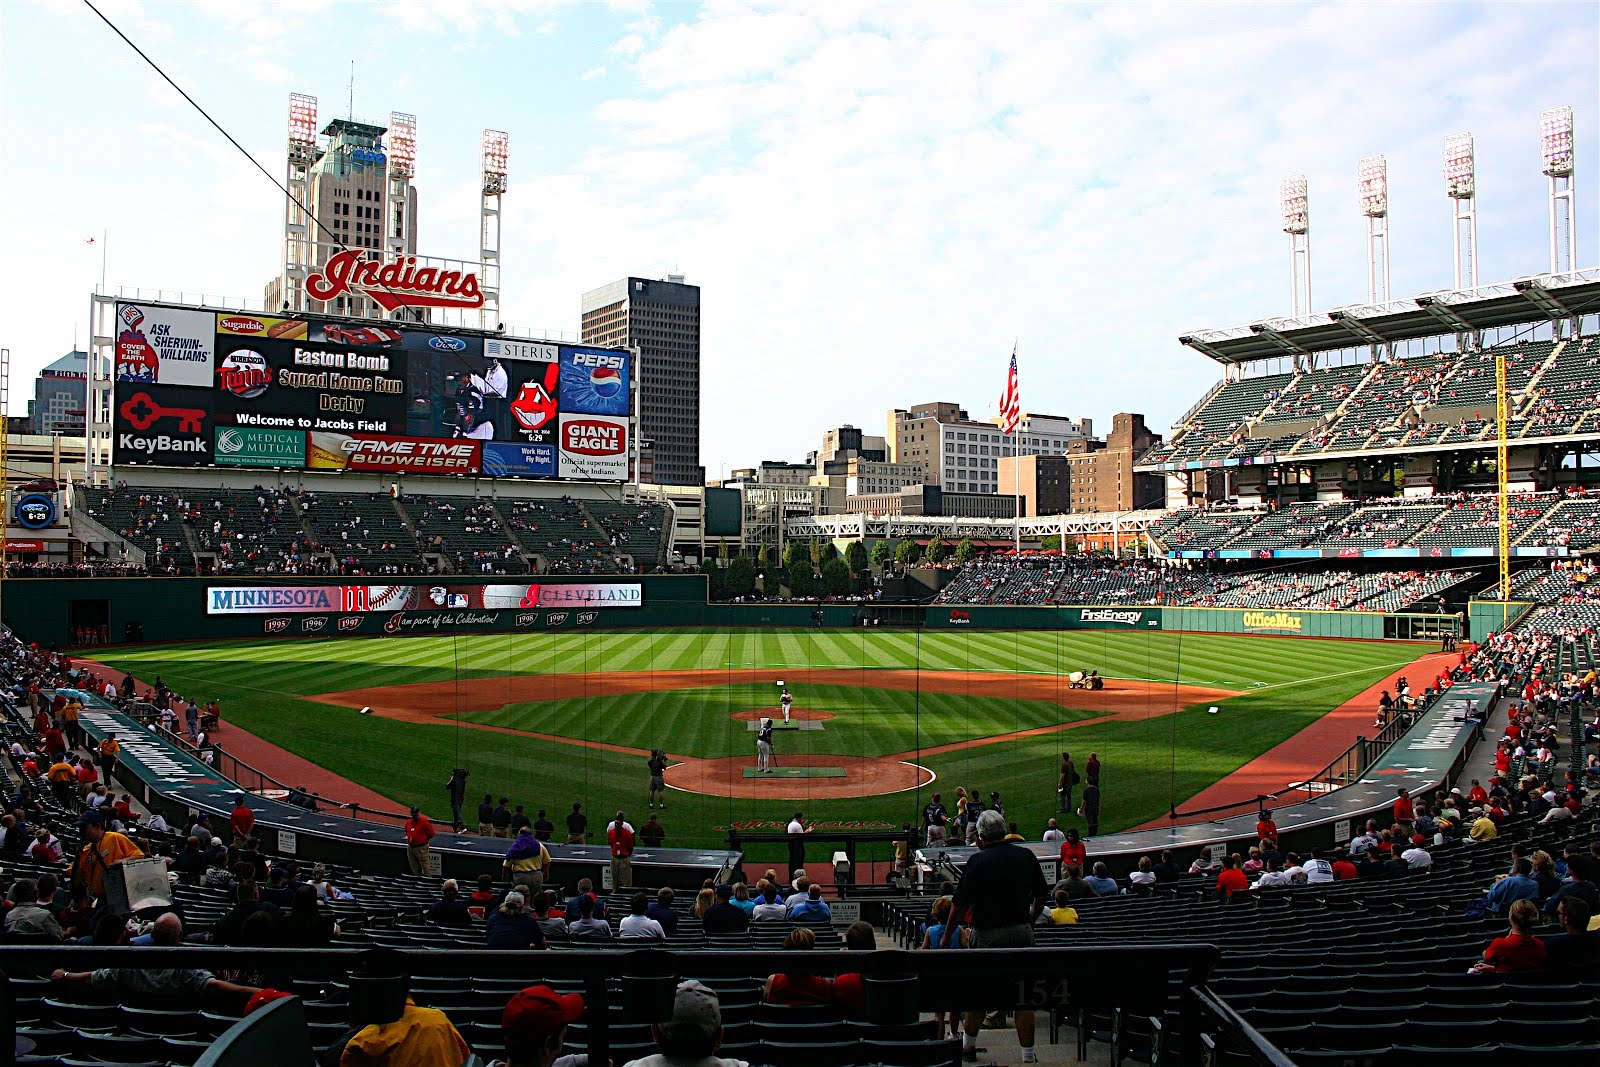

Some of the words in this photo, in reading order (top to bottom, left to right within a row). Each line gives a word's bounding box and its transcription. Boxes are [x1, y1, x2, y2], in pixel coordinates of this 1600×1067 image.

[305, 249, 485, 312] Indians
[150, 324, 171, 336] ASK
[222, 320, 264, 331] Sugardale
[154, 336, 203, 350] SHERWIN-
[160, 348, 208, 362] WILLIAMS
[504, 344, 552, 360] STERIS
[294, 348, 344, 368] Easton
[348, 352, 390, 371] Bomb
[572, 353, 624, 370] PEPSI
[215, 368, 274, 392] Twins
[279, 369, 328, 388] Squad
[330, 372, 372, 392] Home
[374, 376, 403, 394] Run
[320, 394, 364, 414] Derby
[236, 414, 295, 428] Welcome
[298, 418, 312, 428] to
[314, 418, 354, 430] Jacobs
[358, 420, 387, 432] Field
[528, 434, 542, 442] 6:29
[568, 425, 620, 438] GIANT
[120, 434, 206, 454] KeyBank
[248, 434, 300, 444] MEDICAL
[569, 438, 618, 450] EAGLE
[248, 444, 300, 454] MUTUAL
[340, 440, 416, 454] GAME
[418, 443, 475, 456] TIME
[352, 454, 469, 467] BUDWEISER
[526, 456, 534, 464] Fly
[535, 456, 551, 464] Right.
[562, 458, 585, 466] Official
[586, 460, 626, 468] supermarket
[591, 468, 617, 476] Indians.
[212, 590, 331, 610] MINNESOTA
[542, 588, 640, 601] CLEVELAND
[411, 616, 431, 628] part
[432, 614, 442, 628] of
[442, 614, 454, 624] the
[456, 613, 499, 624] Celebration!
[519, 614, 534, 623] 1998
[550, 614, 564, 622] 1999
[579, 614, 593, 622] 2001
[1081, 609, 1142, 622] FirstEnergy
[1244, 612, 1302, 628] OfficeMax
[268, 620, 286, 630] 1995
[306, 620, 322, 629] 1996
[342, 618, 358, 628] 1997
[1407, 727, 1460, 749] Welcome
[1016, 980, 1071, 1006] 154
